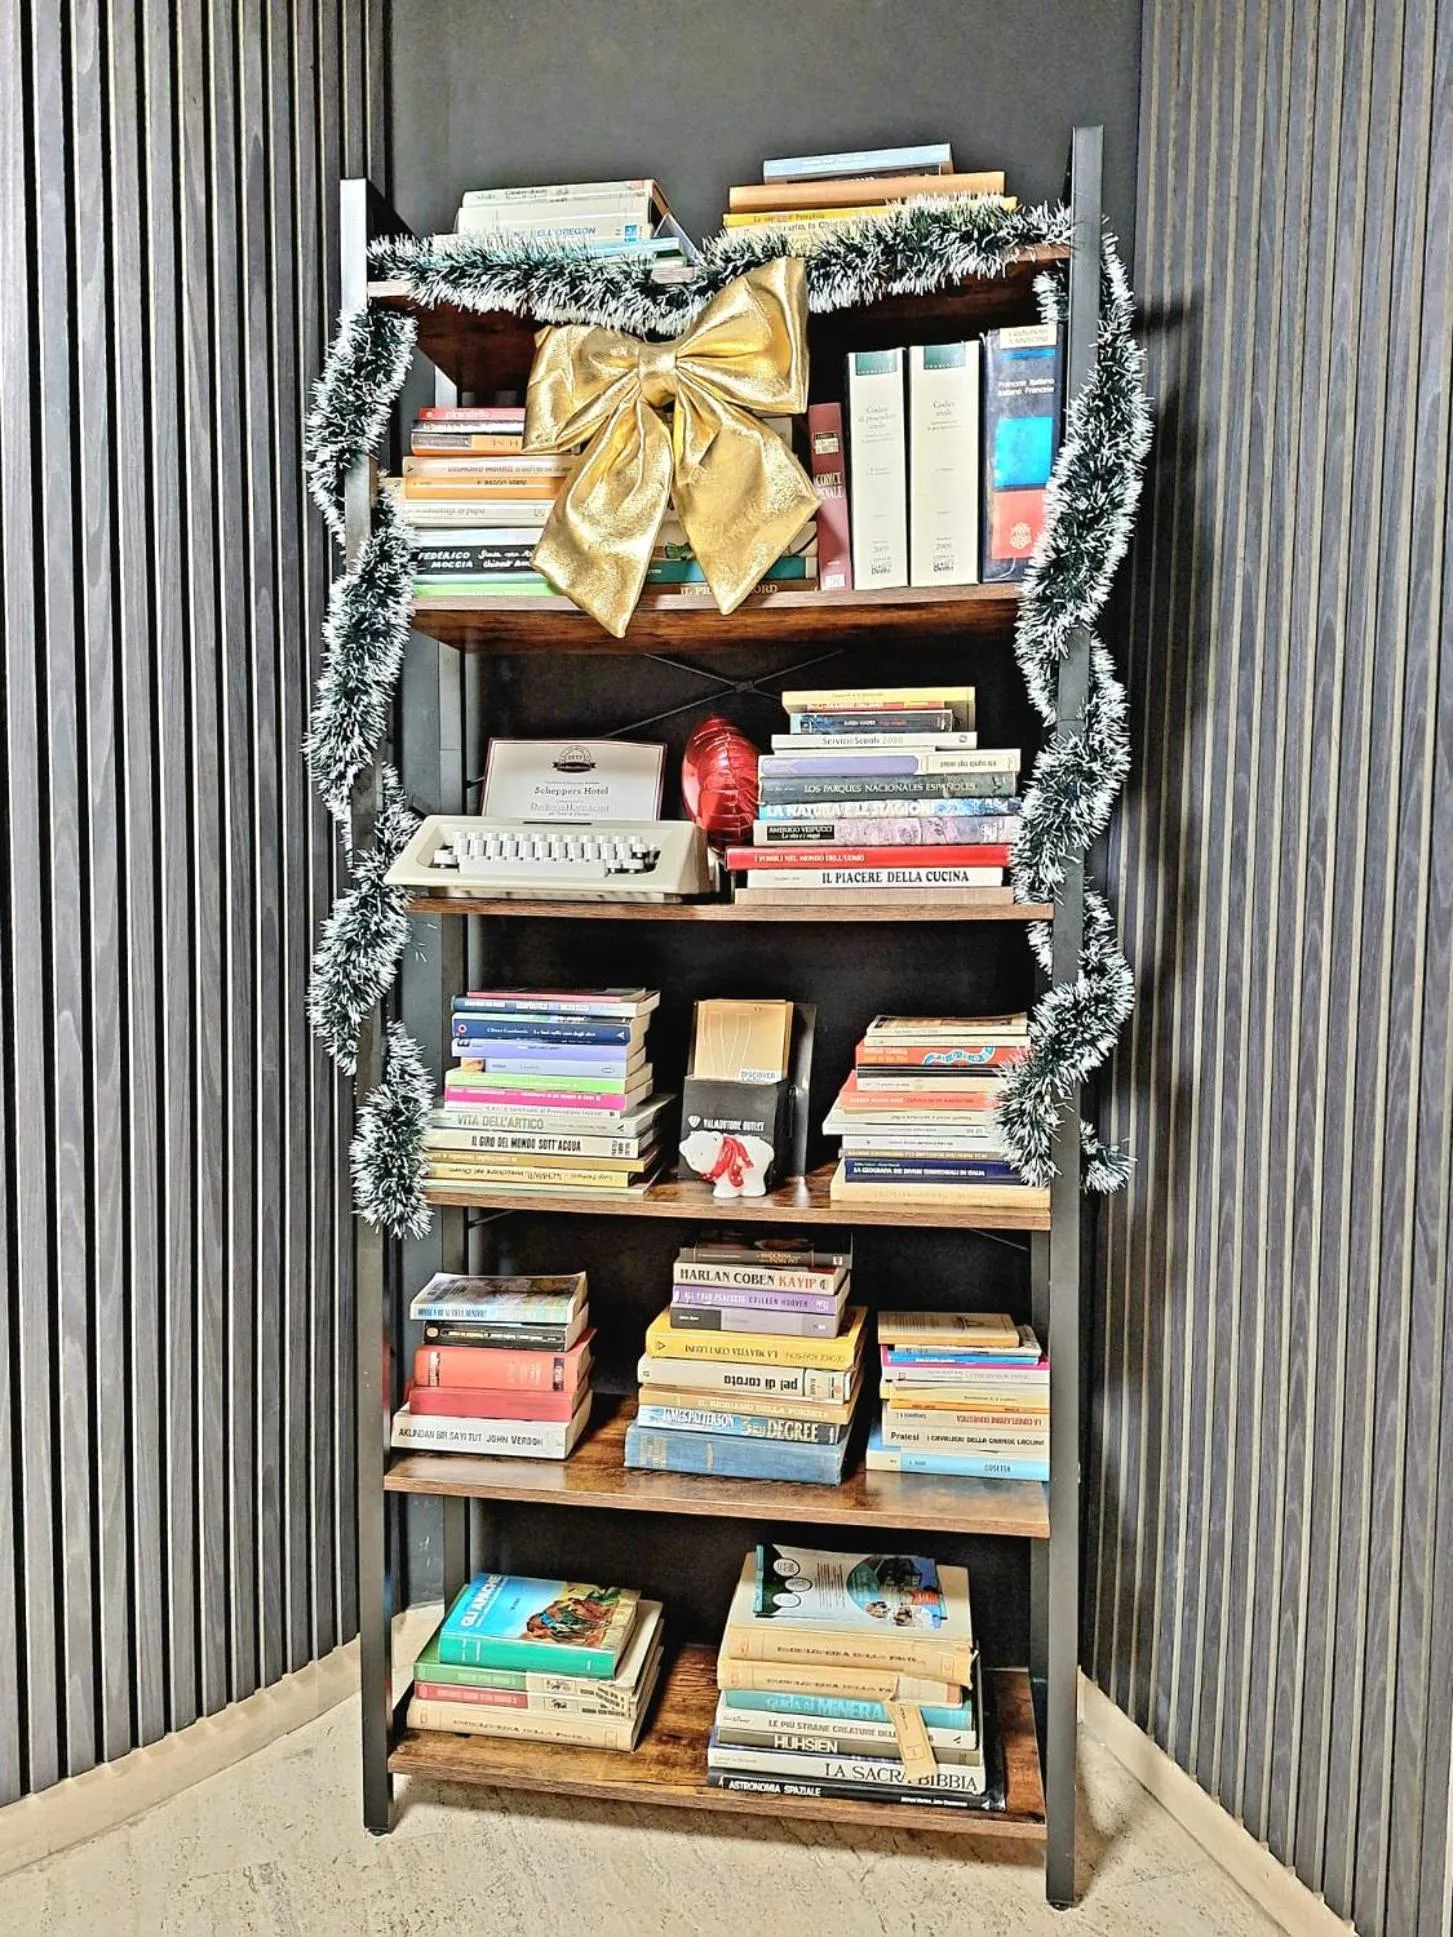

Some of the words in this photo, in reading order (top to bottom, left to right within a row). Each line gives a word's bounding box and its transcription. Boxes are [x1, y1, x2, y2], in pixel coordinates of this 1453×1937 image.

[815, 472, 843, 486] CODICE
[418, 551, 471, 560] FEDERICO
[430, 560, 474, 569] MOCCIA
[751, 583, 779, 595] ORD
[534, 786, 582, 797] Scheppers
[584, 786, 609, 795] Hotel
[803, 783, 822, 793] LOS
[823, 783, 863, 795] PARQUES
[864, 782, 924, 793] NACIONALES
[925, 780, 976, 792] ESPAÑOLES
[766, 804, 785, 818] LA
[786, 803, 842, 818] NATURA
[873, 801, 935, 816] STAGIONI
[768, 826, 800, 834] AMERIGO
[800, 825, 832, 833] VESPUCCI
[799, 854, 824, 863] MONDO
[822, 872, 834, 884] IL
[835, 871, 883, 884] PIACERE
[886, 871, 923, 883] DELLA
[925, 870, 970, 883] CUCINA
[741, 1070, 776, 1079] DISCOVER
[457, 1113, 480, 1126] VITA
[482, 1115, 545, 1130] DELL'ARTICO
[743, 1121, 765, 1132] OUTLET
[471, 1136, 478, 1147] IL
[479, 1136, 496, 1148] GIRO
[498, 1136, 509, 1148] DEL
[510, 1137, 537, 1150] MONDO
[538, 1138, 582, 1152] SOTT'ACQUA
[862, 1167, 893, 1175] GEOGRAFIA
[679, 1267, 731, 1283] HARLAN
[733, 1269, 776, 1286] COBEN
[779, 1274, 817, 1290] KAYIP
[748, 1296, 779, 1306] COLLEEN
[781, 1298, 809, 1308] HOOVER
[684, 1343, 708, 1356] LEONI
[731, 1347, 752, 1359] VITA
[767, 1349, 778, 1360] LA
[765, 1377, 777, 1391] di
[710, 1400, 754, 1412] RICHIAMO
[755, 1404, 786, 1414] DELLA
[787, 1407, 829, 1419] FORESTA
[663, 1408, 688, 1424] JAMES
[687, 1410, 736, 1429] PATTERSON
[767, 1420, 819, 1443] DEGREE
[449, 1431, 467, 1441] SAYI
[468, 1433, 483, 1442] TUT
[486, 1434, 509, 1445] JOHN
[510, 1436, 544, 1447] VERDON
[890, 1431, 920, 1441] Pratesi
[931, 1435, 965, 1443] CAVALIERI
[966, 1436, 988, 1444] DELLA
[988, 1437, 1016, 1445] GRANDE
[777, 1646, 850, 1658] ENCICLOPEDIA
[766, 1677, 839, 1690] ENCICLOPEDIA
[768, 1719, 778, 1729] LE
[796, 1721, 830, 1735] STRANE
[832, 1724, 875, 1737] CREATURE
[774, 1735, 839, 1754] HUHSIEN
[825, 1762, 846, 1778] LA
[917, 1773, 979, 1792] BIBBIA
[728, 1779, 781, 1794] ASTRONOMIA
[783, 1784, 822, 1797] SPAZIALE
